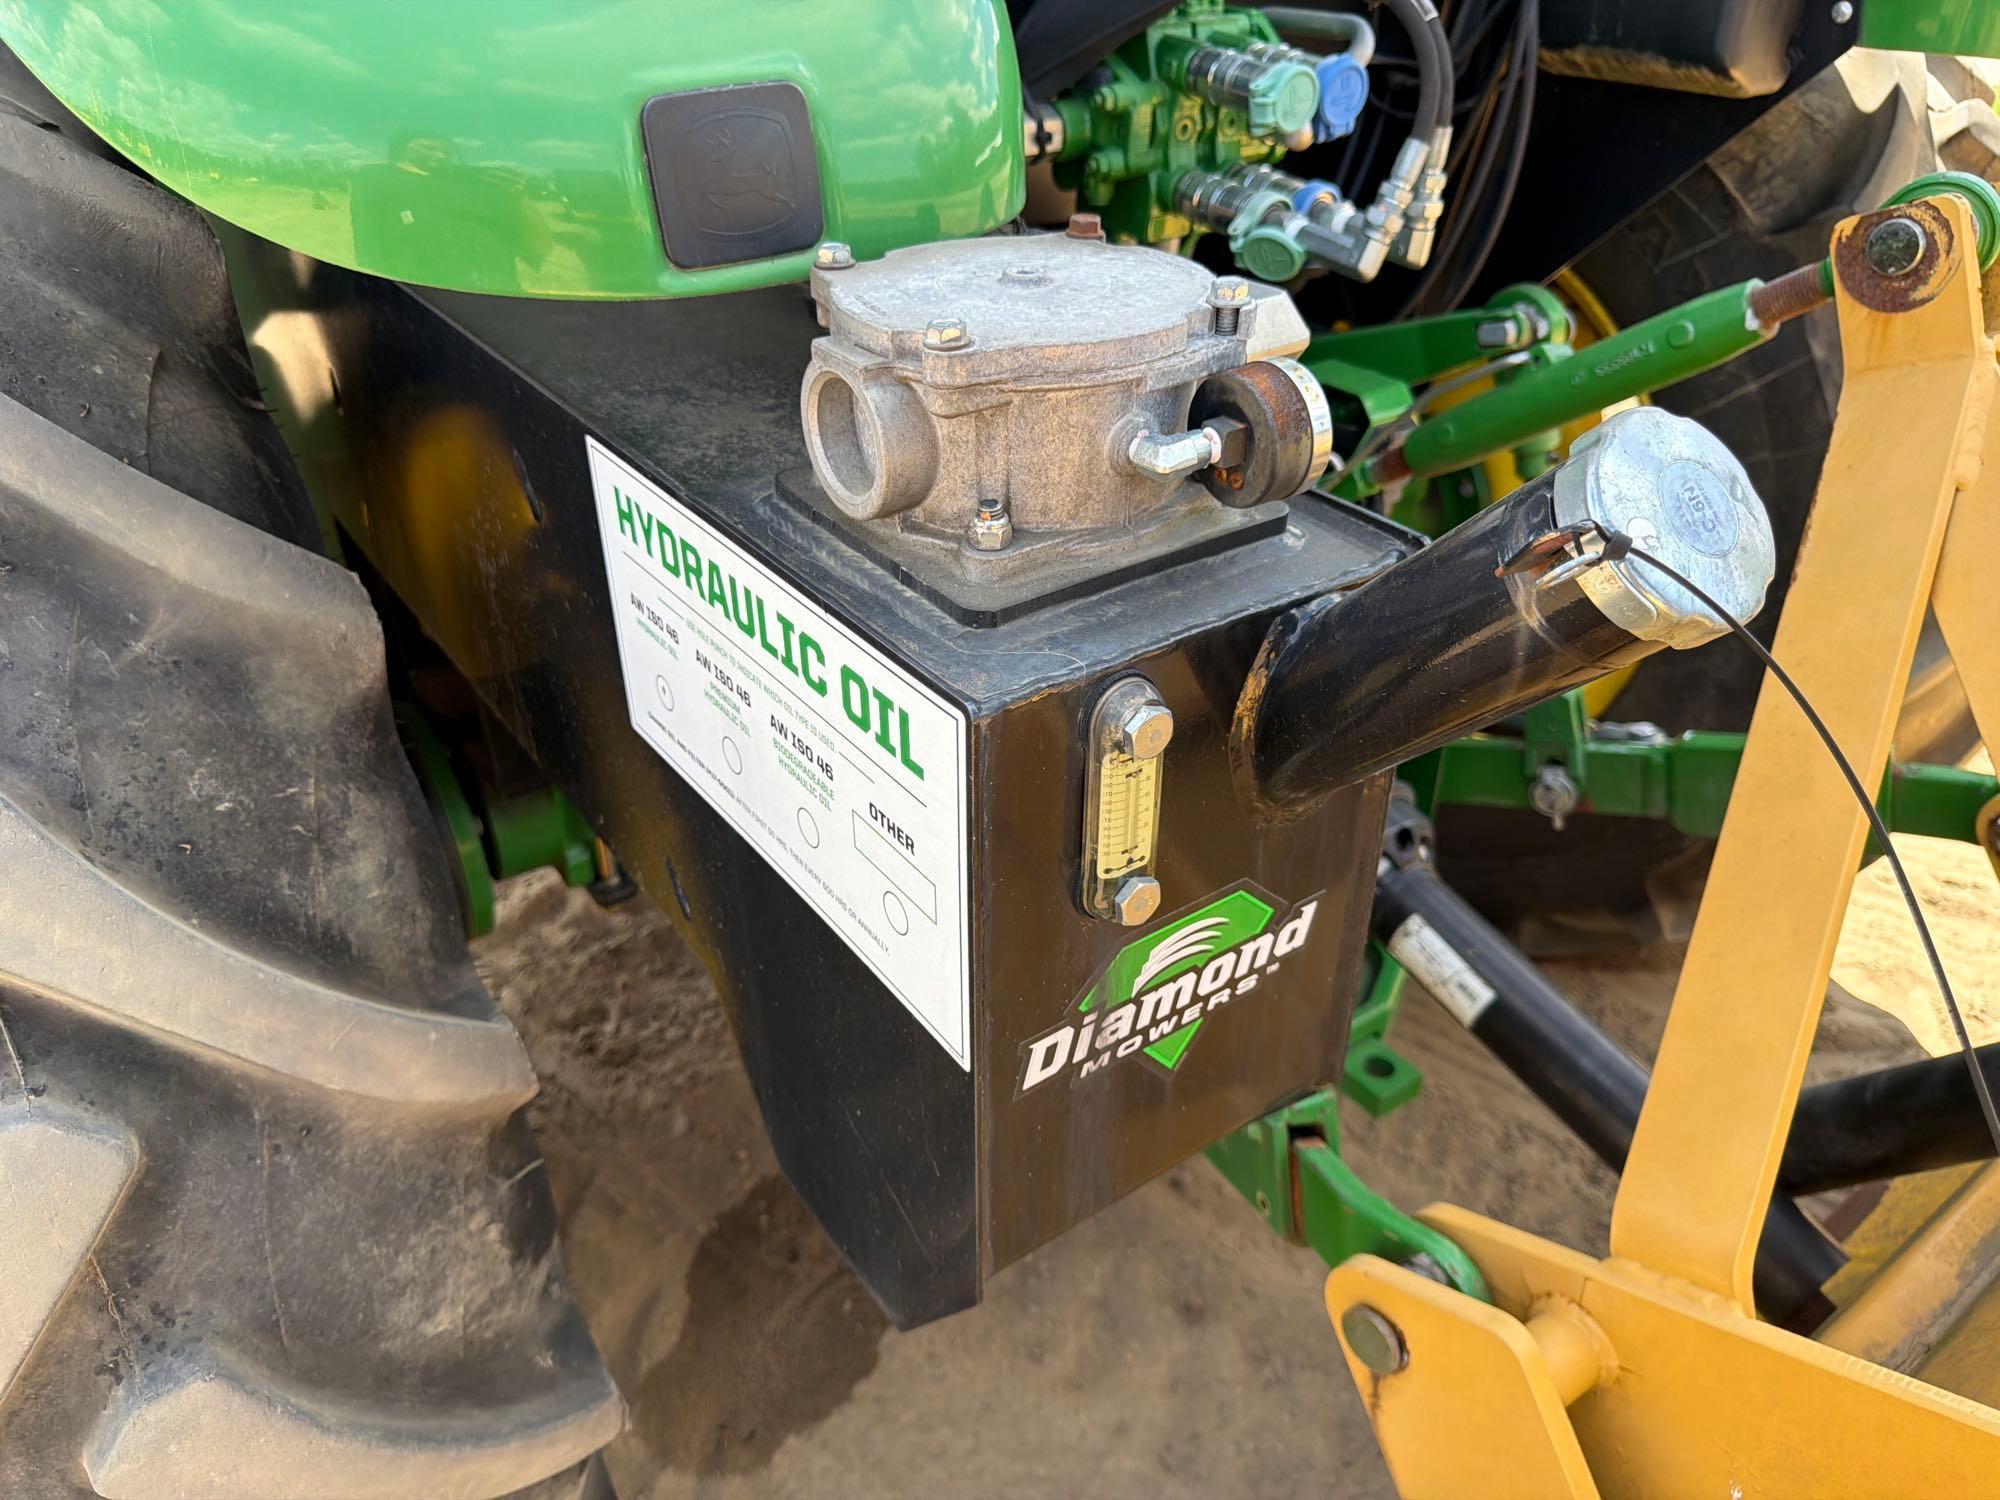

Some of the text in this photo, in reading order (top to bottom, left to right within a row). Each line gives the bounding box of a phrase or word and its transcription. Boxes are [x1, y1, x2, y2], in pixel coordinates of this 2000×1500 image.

[614, 486, 924, 781] HYDRAULIC OIL
[631, 593, 679, 644] AW ISO 46
[637, 617, 678, 660] HYDRAULIC OIL
[686, 618, 696, 632] USE
[729, 654, 736, 667] TO
[735, 660, 762, 690] INDICATE
[763, 685, 782, 707] WHICH
[782, 698, 794, 717] OIL
[795, 710, 811, 732] TYPE
[810, 724, 817, 736] IS
[818, 731, 836, 753] USED.
[696, 649, 751, 707] AW ISO 46
[710, 681, 741, 715] PREMIUM
[704, 689, 751, 738] HYDRAULIC OIL
[771, 715, 833, 781] AW ISO 46
[773, 737, 835, 800] BIODEGRADEABLE
[778, 756, 832, 812] HYDRAULIC OIL
[869, 802, 914, 856] OTHER
[752, 811, 767, 830] FIRST
[789, 848, 803, 867] THEN
[805, 863, 821, 884] EVERY
[822, 881, 836, 900] 500
[848, 908, 857, 921] OR
[1022, 901, 1318, 1091] Diamond
[1080, 973, 1259, 1079] MOWERS
